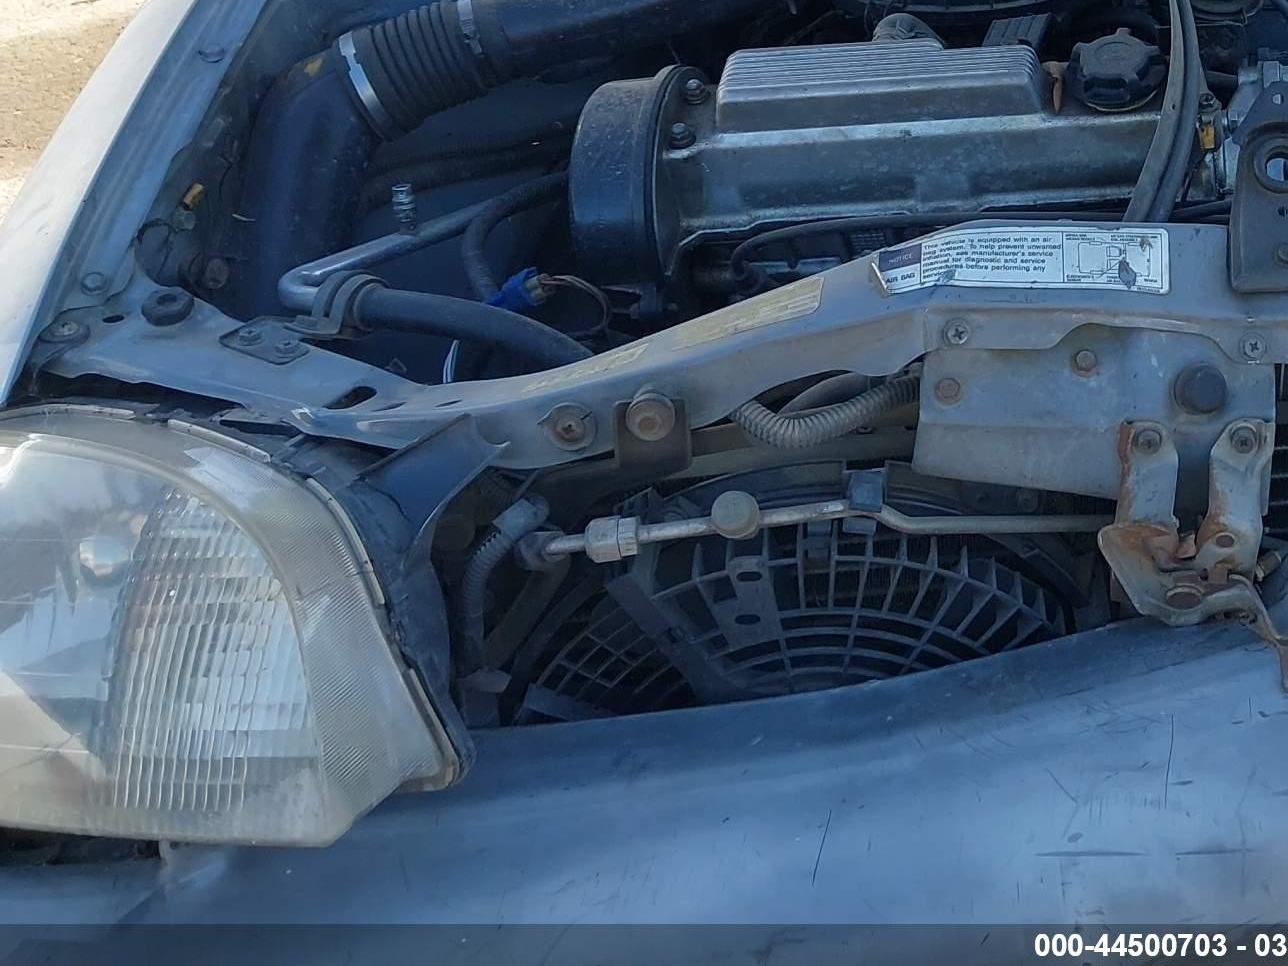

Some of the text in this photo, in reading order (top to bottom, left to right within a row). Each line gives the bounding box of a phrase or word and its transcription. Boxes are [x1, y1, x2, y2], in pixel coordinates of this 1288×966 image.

[923, 257, 950, 267] manual
[964, 256, 1002, 264] diagnostic
[923, 264, 964, 274] procedures
[991, 264, 1031, 274] performing
[900, 272, 916, 281] BAG
